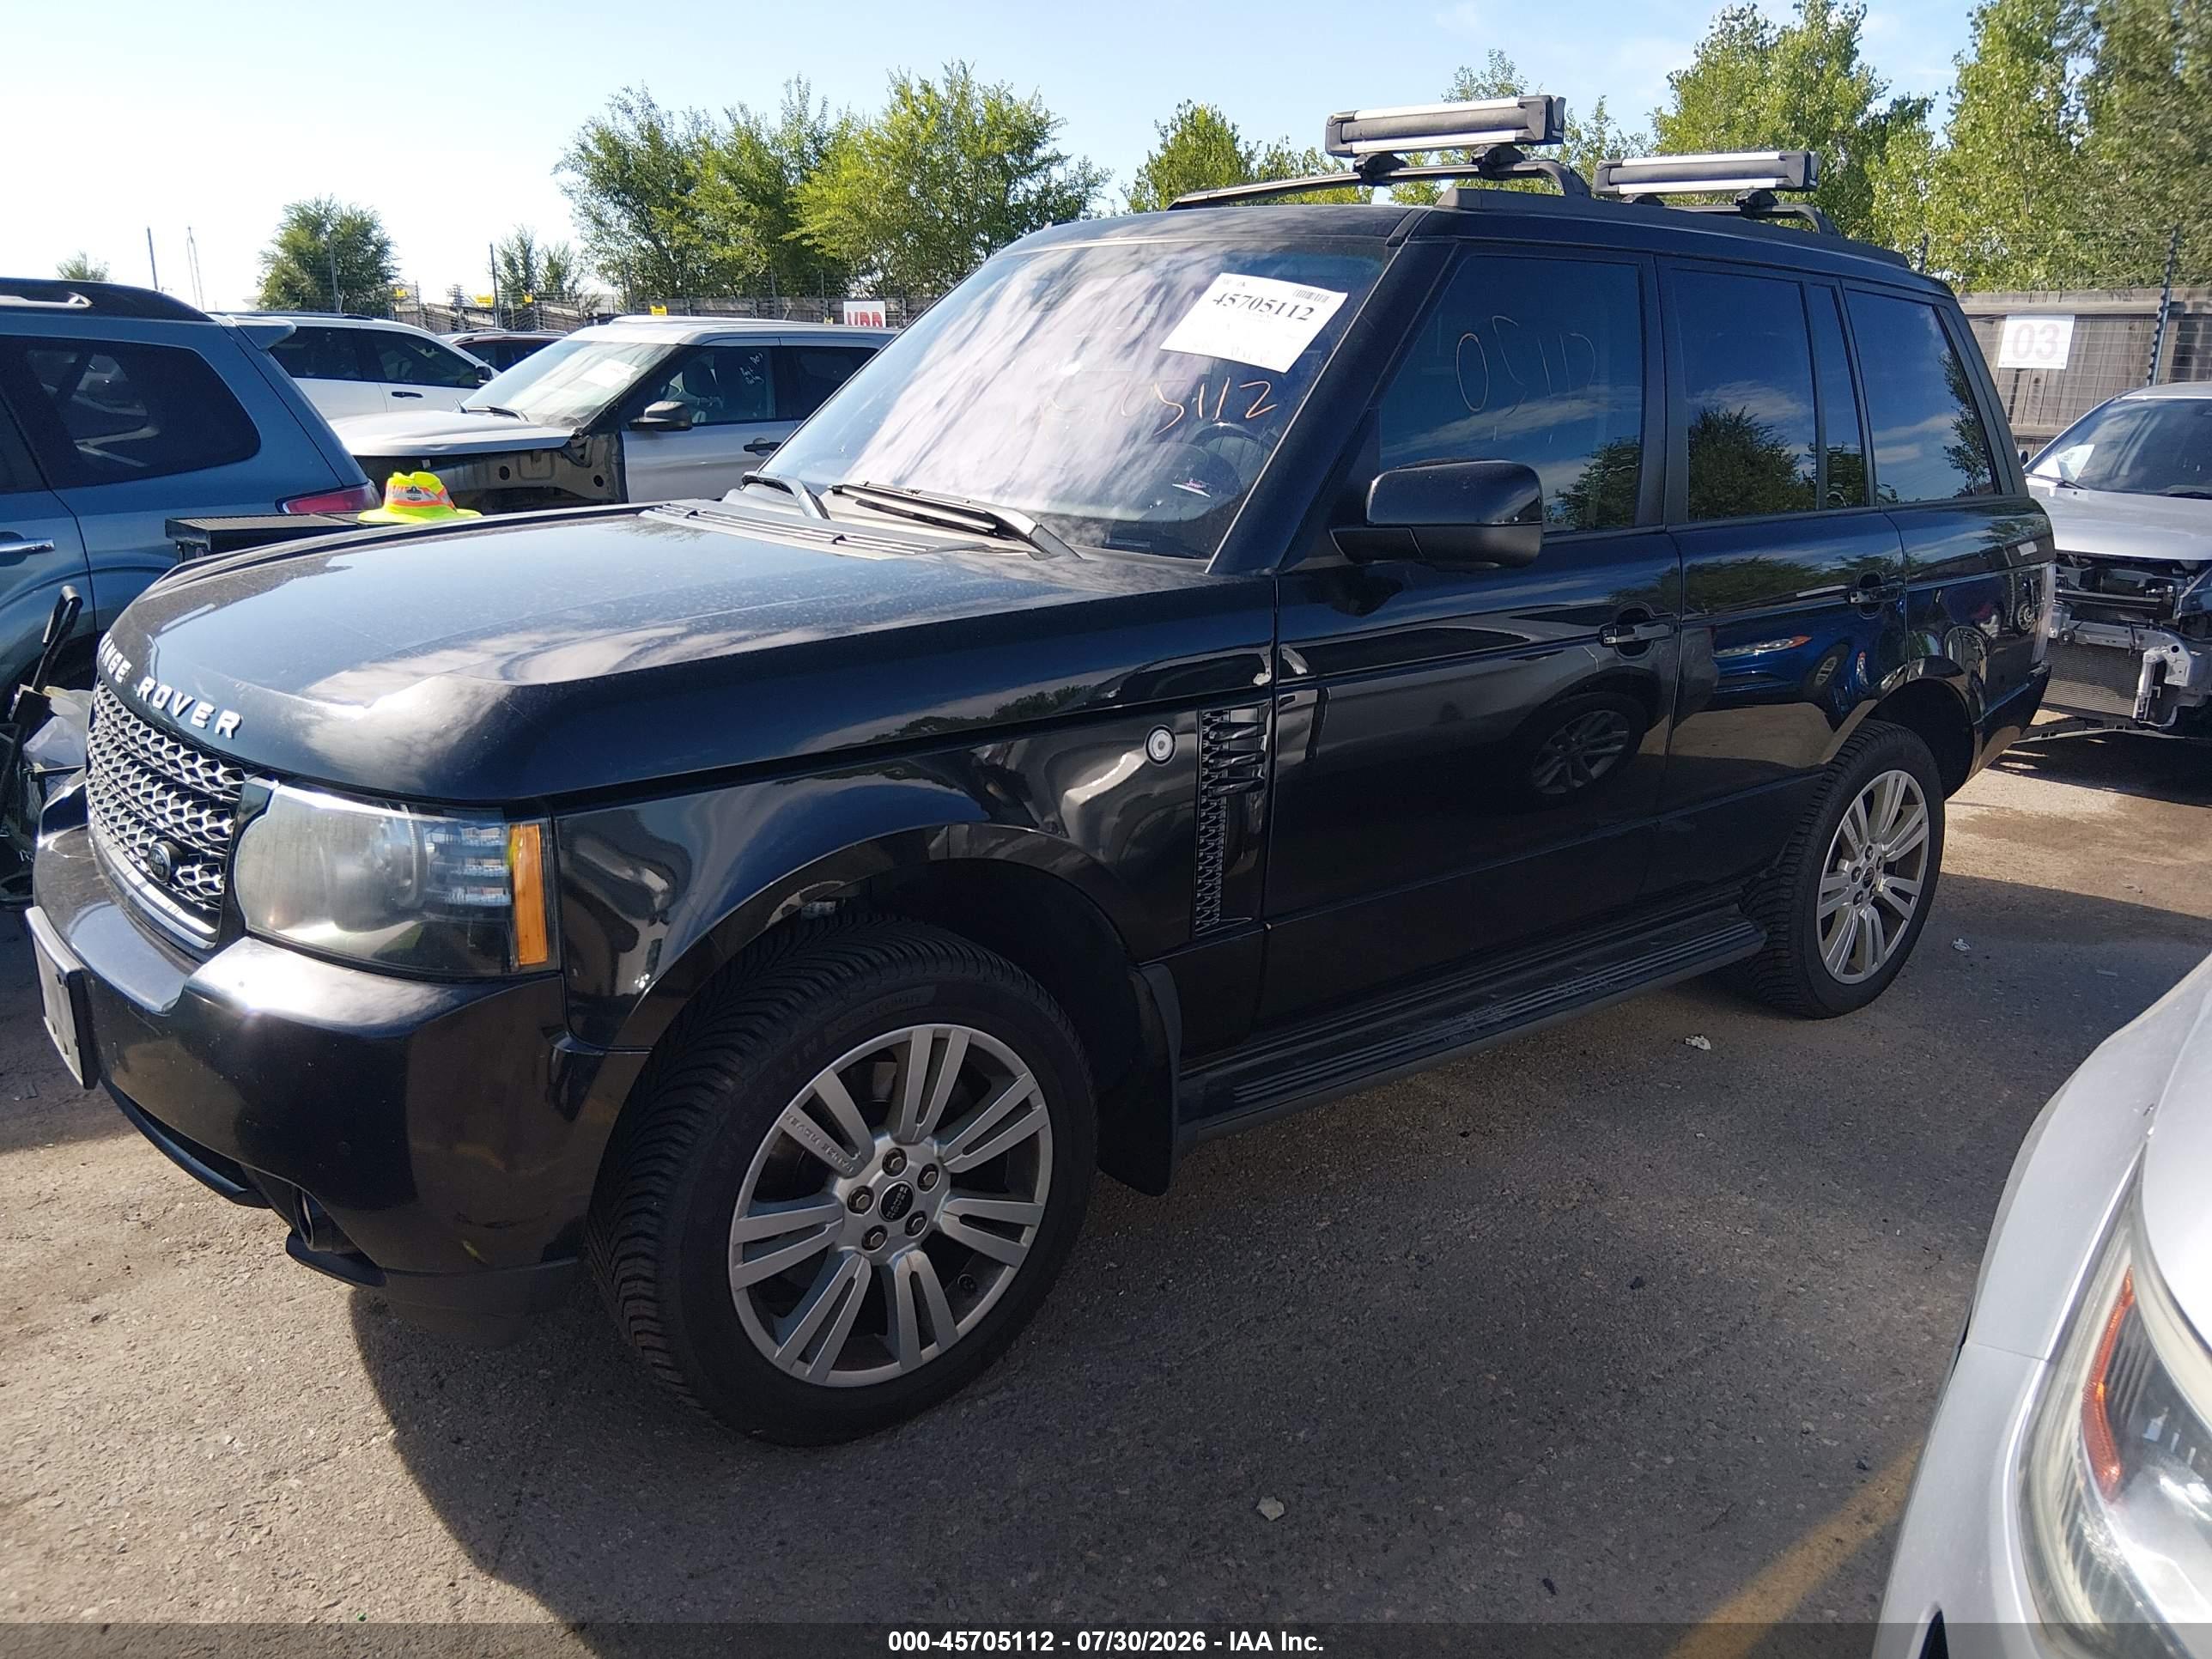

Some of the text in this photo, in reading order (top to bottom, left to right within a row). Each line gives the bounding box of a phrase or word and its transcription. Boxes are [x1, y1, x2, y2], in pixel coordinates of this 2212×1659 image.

[1212, 292, 1316, 321] 45705112
[2013, 323, 2060, 361] 03
[137, 676, 244, 739] ROVER
